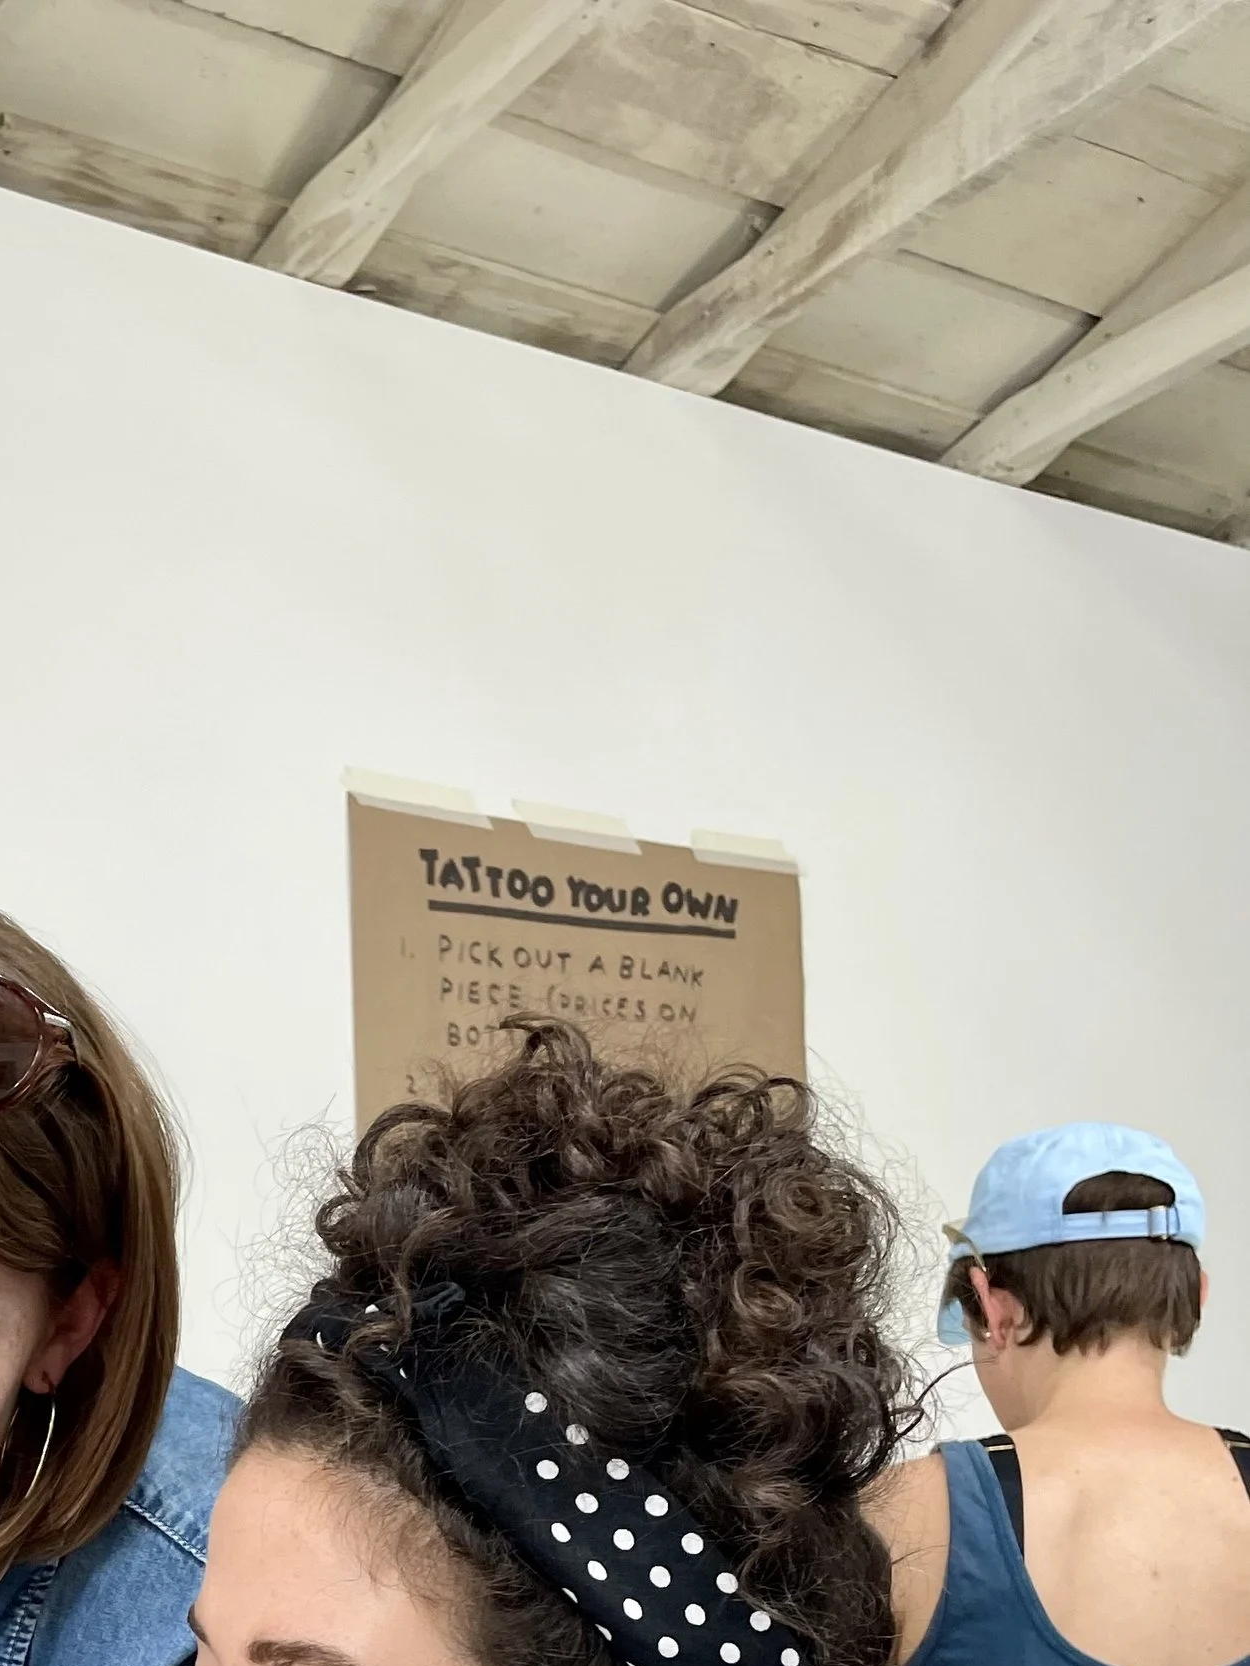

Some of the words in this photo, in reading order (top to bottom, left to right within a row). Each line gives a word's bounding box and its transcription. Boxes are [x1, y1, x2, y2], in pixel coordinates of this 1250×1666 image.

[418, 848, 555, 907] TATTOO
[566, 874, 651, 916] YOUR
[661, 881, 739, 923] OWN
[438, 934, 503, 968] PICK
[513, 946, 571, 974] OUT
[588, 955, 606, 976] A
[618, 954, 704, 989] BLANK
[440, 977, 521, 1008] PIECE
[659, 1002, 697, 1025] ON
